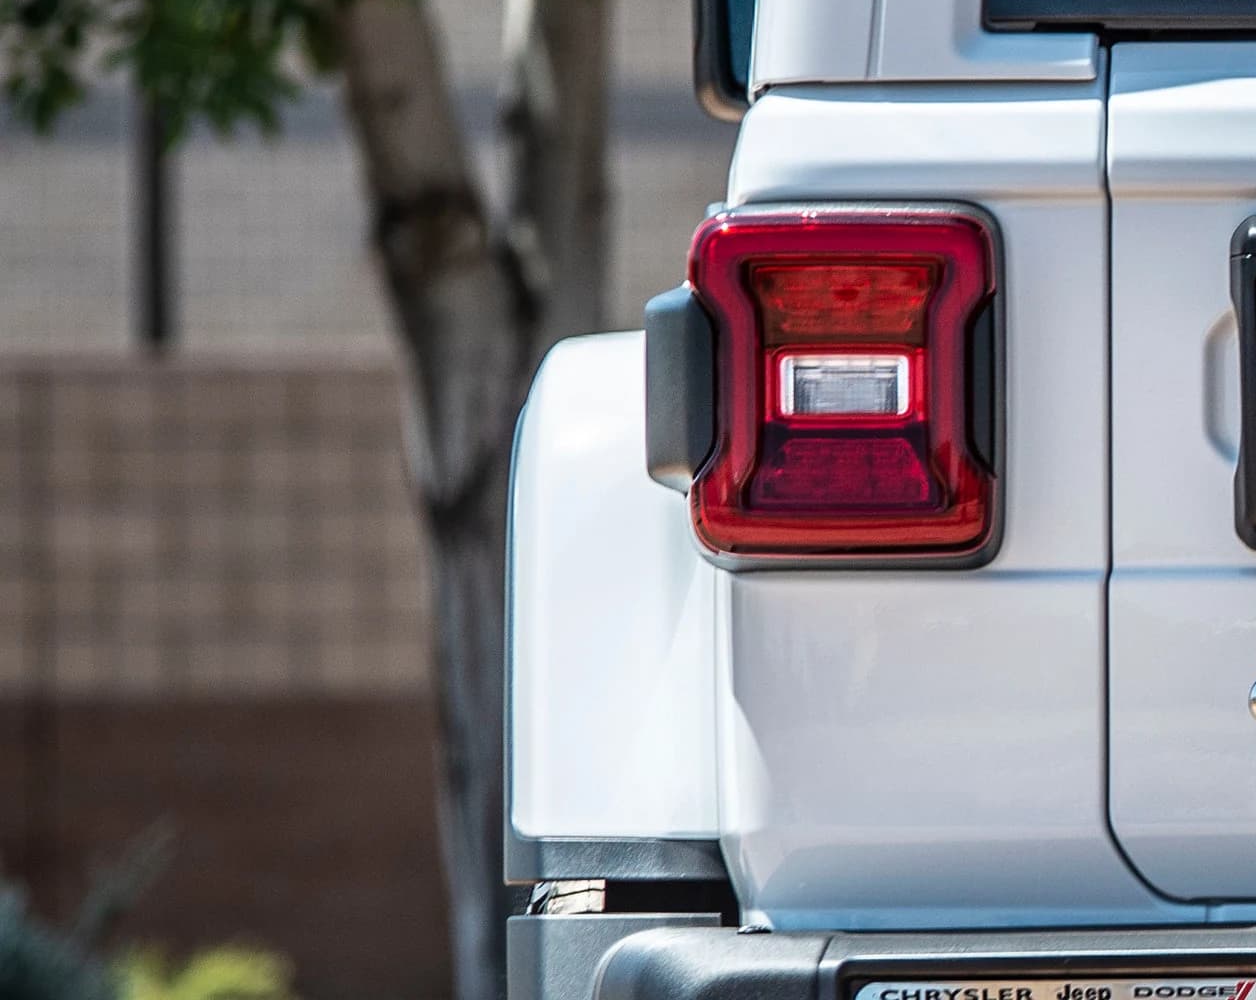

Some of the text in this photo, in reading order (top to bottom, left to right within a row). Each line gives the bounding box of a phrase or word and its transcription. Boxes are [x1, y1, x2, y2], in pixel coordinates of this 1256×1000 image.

[879, 987, 1033, 1000] CHRYSLER
[1055, 984, 1112, 1000] Jeep
[1133, 986, 1240, 998] DODGE
